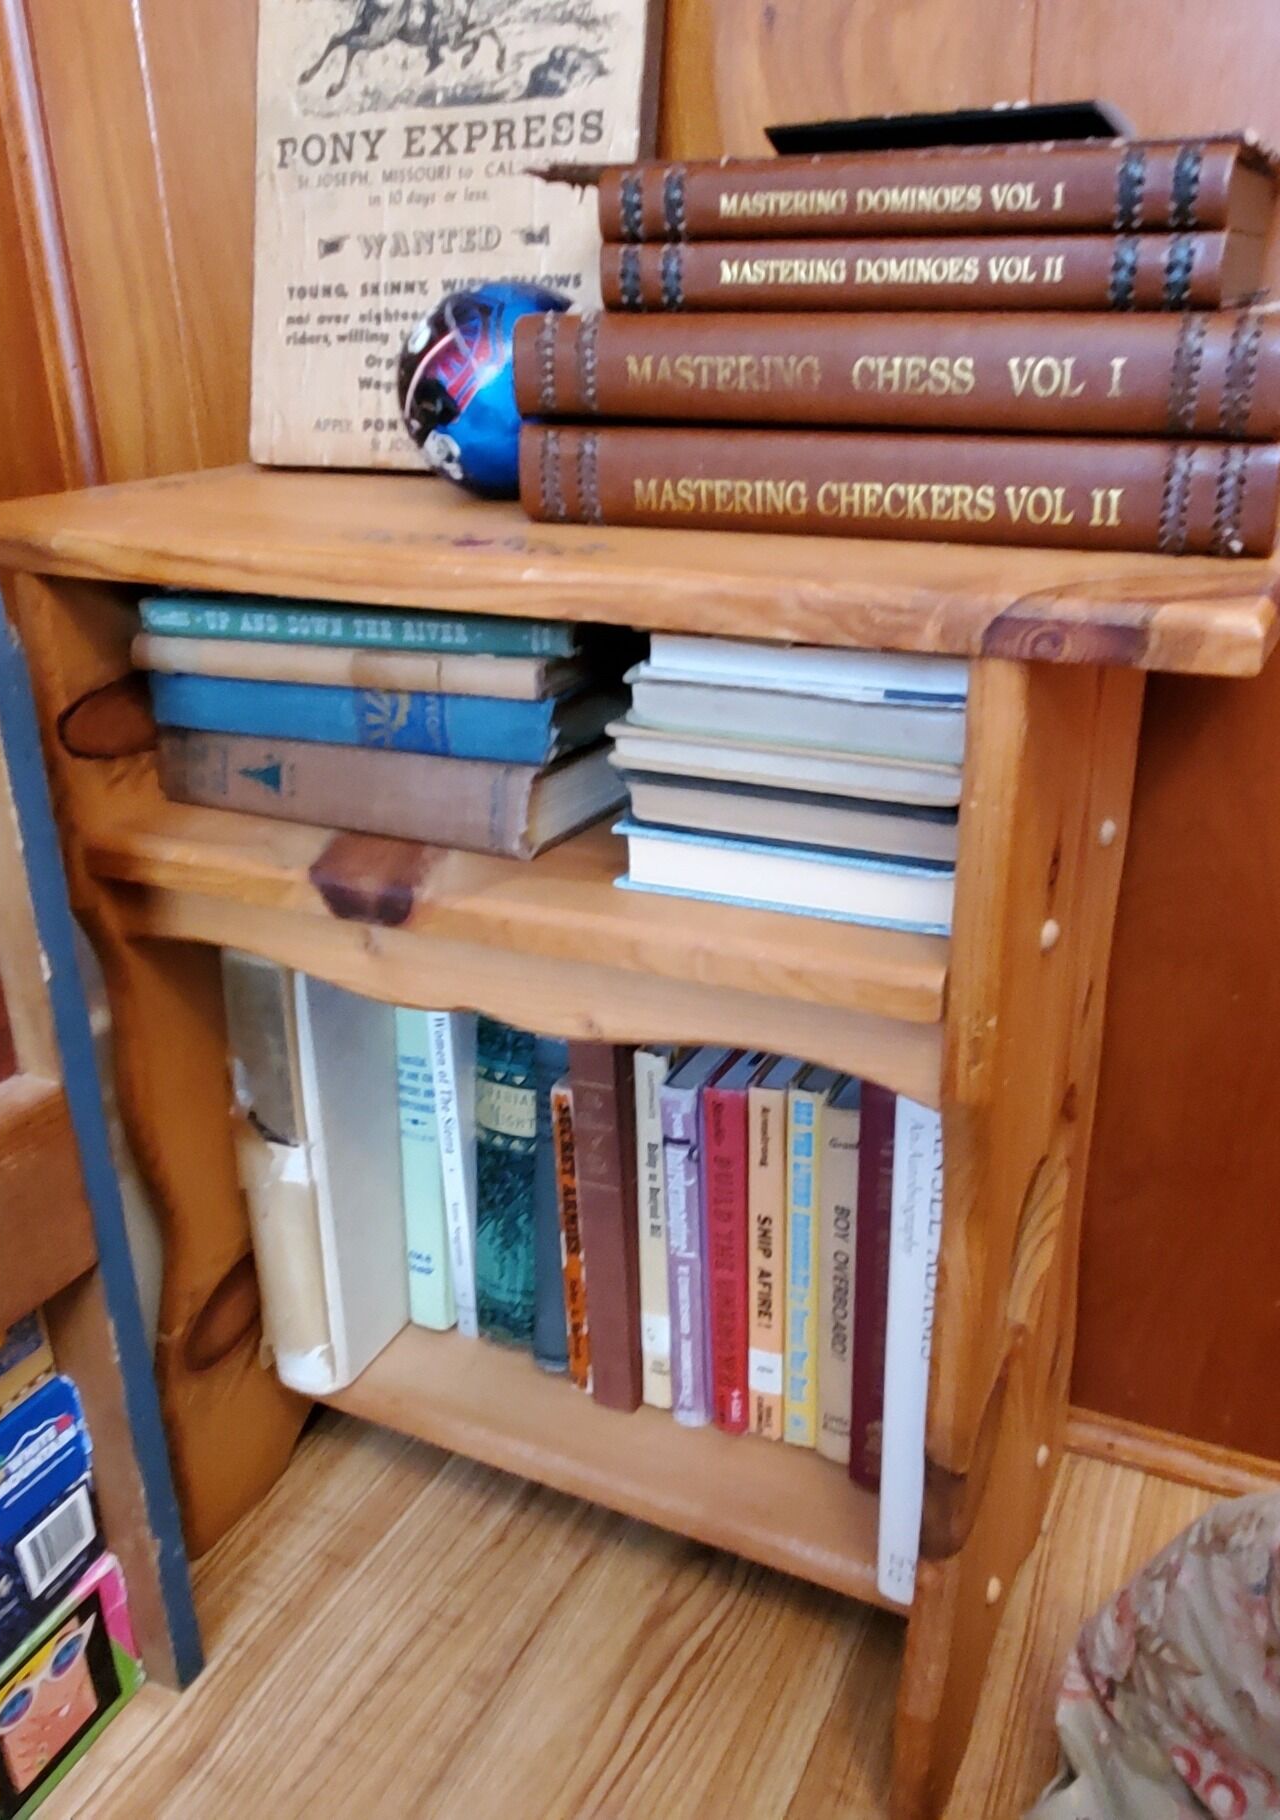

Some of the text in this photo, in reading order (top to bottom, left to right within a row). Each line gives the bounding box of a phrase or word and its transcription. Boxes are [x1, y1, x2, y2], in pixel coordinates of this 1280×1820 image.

[277, 110, 606, 169] PONY EXPRESS
[382, 163, 452, 183] MISSOURI
[720, 181, 1066, 218] MASTERING DOMINOES VOL I
[357, 225, 502, 260] WANTED
[720, 255, 1066, 285] MASTERING DOMINOES VOL II
[337, 328, 389, 345] willing
[625, 353, 1129, 399] MASTERING CHESS VOL I
[633, 477, 1126, 527] MASTERING CHECKERS VOL II
[204, 611, 231, 632] UP
[240, 613, 279, 633] AND
[287, 616, 344, 638] DOWN
[353, 619, 393, 640] THE
[402, 621, 469, 646] RIVER
[433, 1017, 447, 1063] Women
[756, 1214, 773, 1259] SHIP
[833, 1205, 851, 1243] BOY
